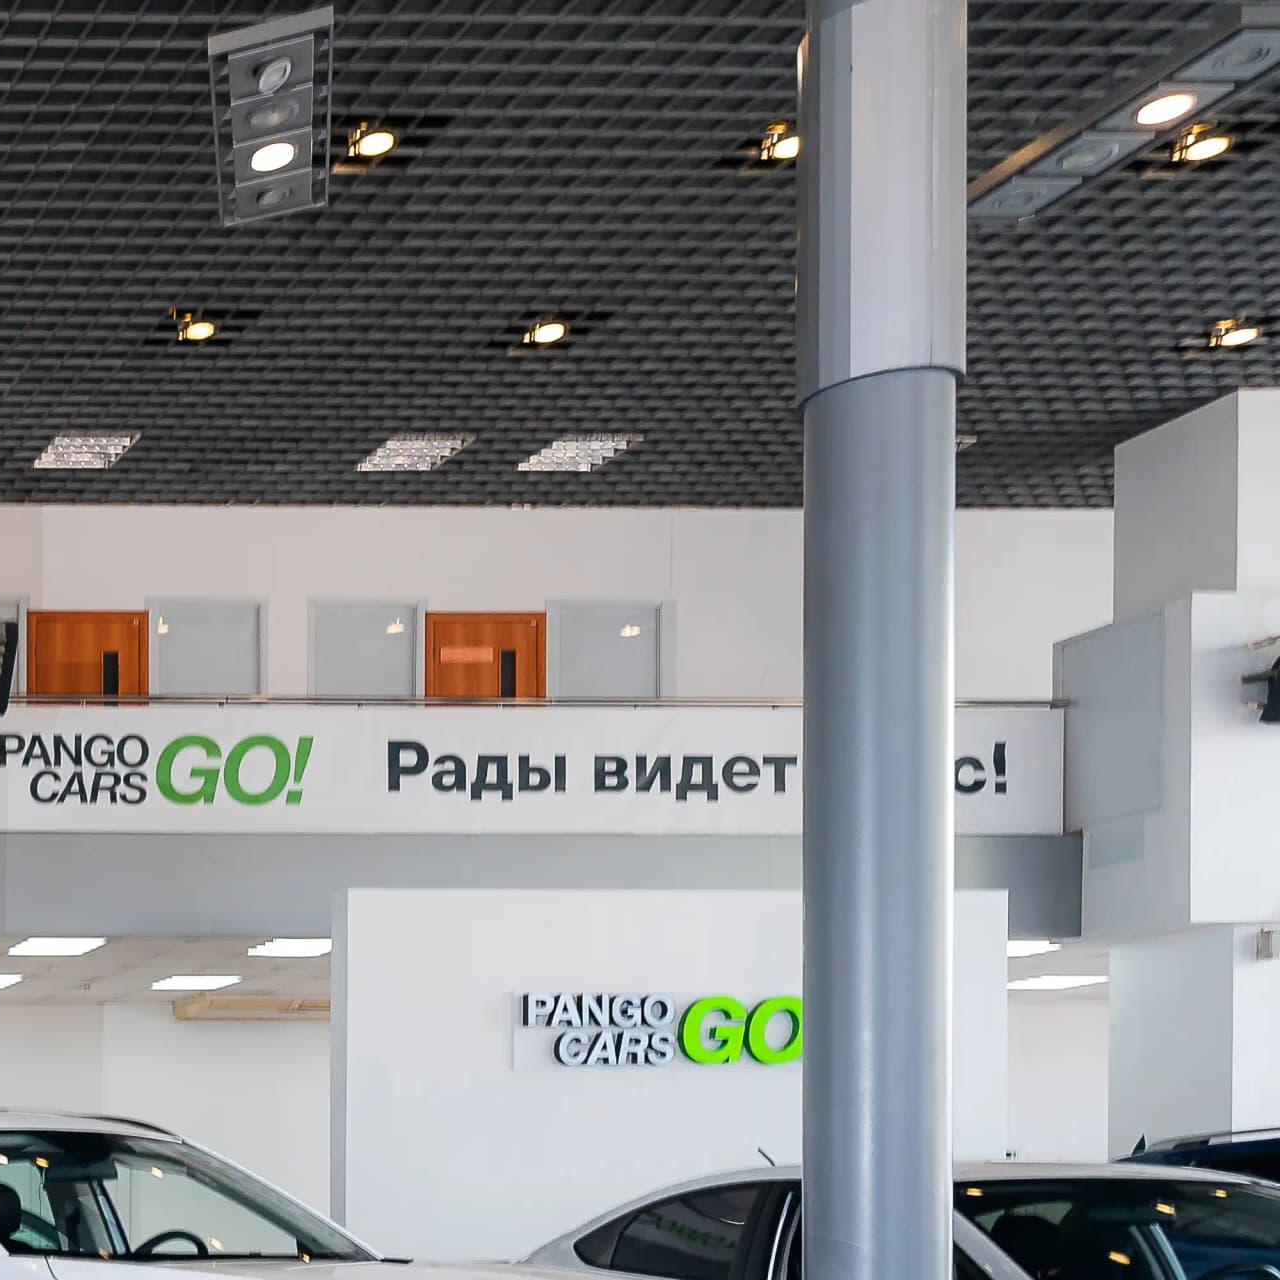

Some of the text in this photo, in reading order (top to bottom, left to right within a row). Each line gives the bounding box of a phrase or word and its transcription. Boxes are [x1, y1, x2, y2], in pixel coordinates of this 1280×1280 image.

[29, 770, 149, 805] CARS
[156, 734, 313, 805] GO!
[387, 740, 566, 801] Рады
[593, 755, 798, 801] видет
[522, 993, 675, 1028] PANGO
[677, 995, 803, 1065] GO
[552, 1029, 675, 1067] CARS
